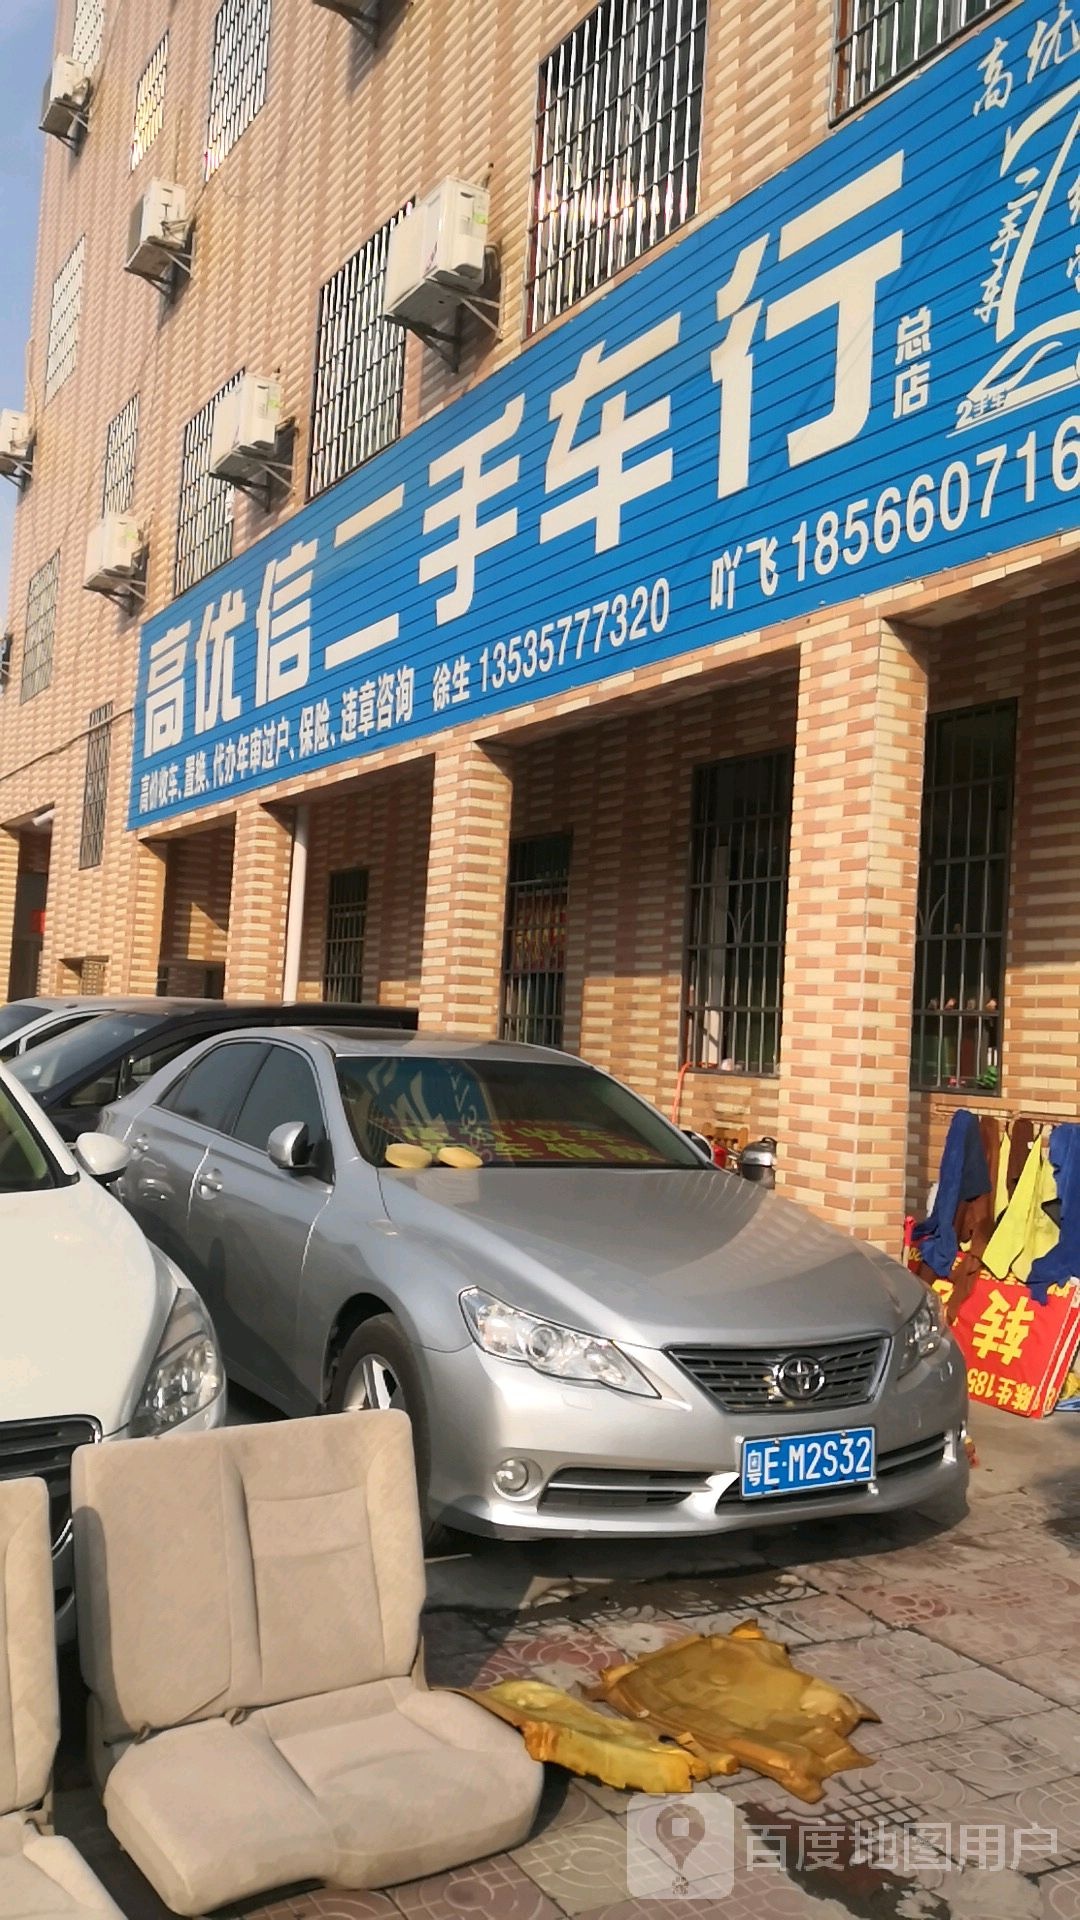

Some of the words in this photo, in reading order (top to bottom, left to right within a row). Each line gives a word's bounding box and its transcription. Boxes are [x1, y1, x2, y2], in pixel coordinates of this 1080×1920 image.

[893, 306, 932, 419] 总店
[142, 150, 904, 758] 高优信二手车行
[432, 655, 471, 712] 徐生
[479, 577, 670, 693] 13535777320
[971, 1288, 1035, 1366] 转
